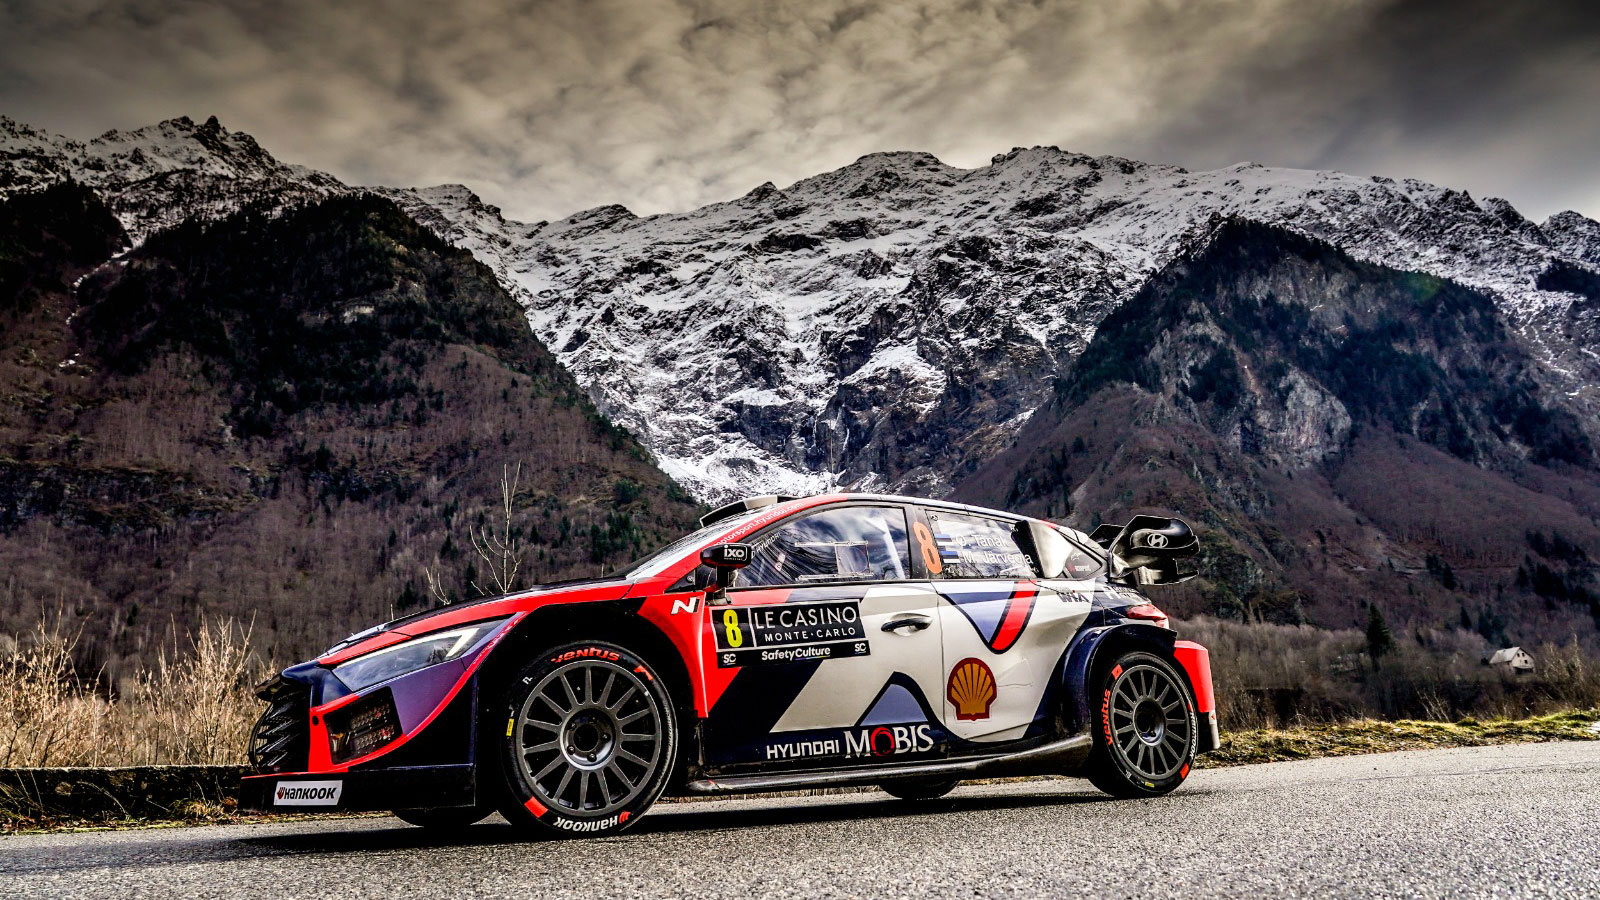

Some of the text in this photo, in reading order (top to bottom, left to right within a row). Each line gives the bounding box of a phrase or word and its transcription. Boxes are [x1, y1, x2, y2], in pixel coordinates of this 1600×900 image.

[912, 521, 942, 575] 8
[723, 609, 743, 648] 8
[754, 606, 857, 629] LE CASINO
[761, 646, 831, 662] SafetyCulture
[766, 724, 934, 760] HYUNDAI MOBIS
